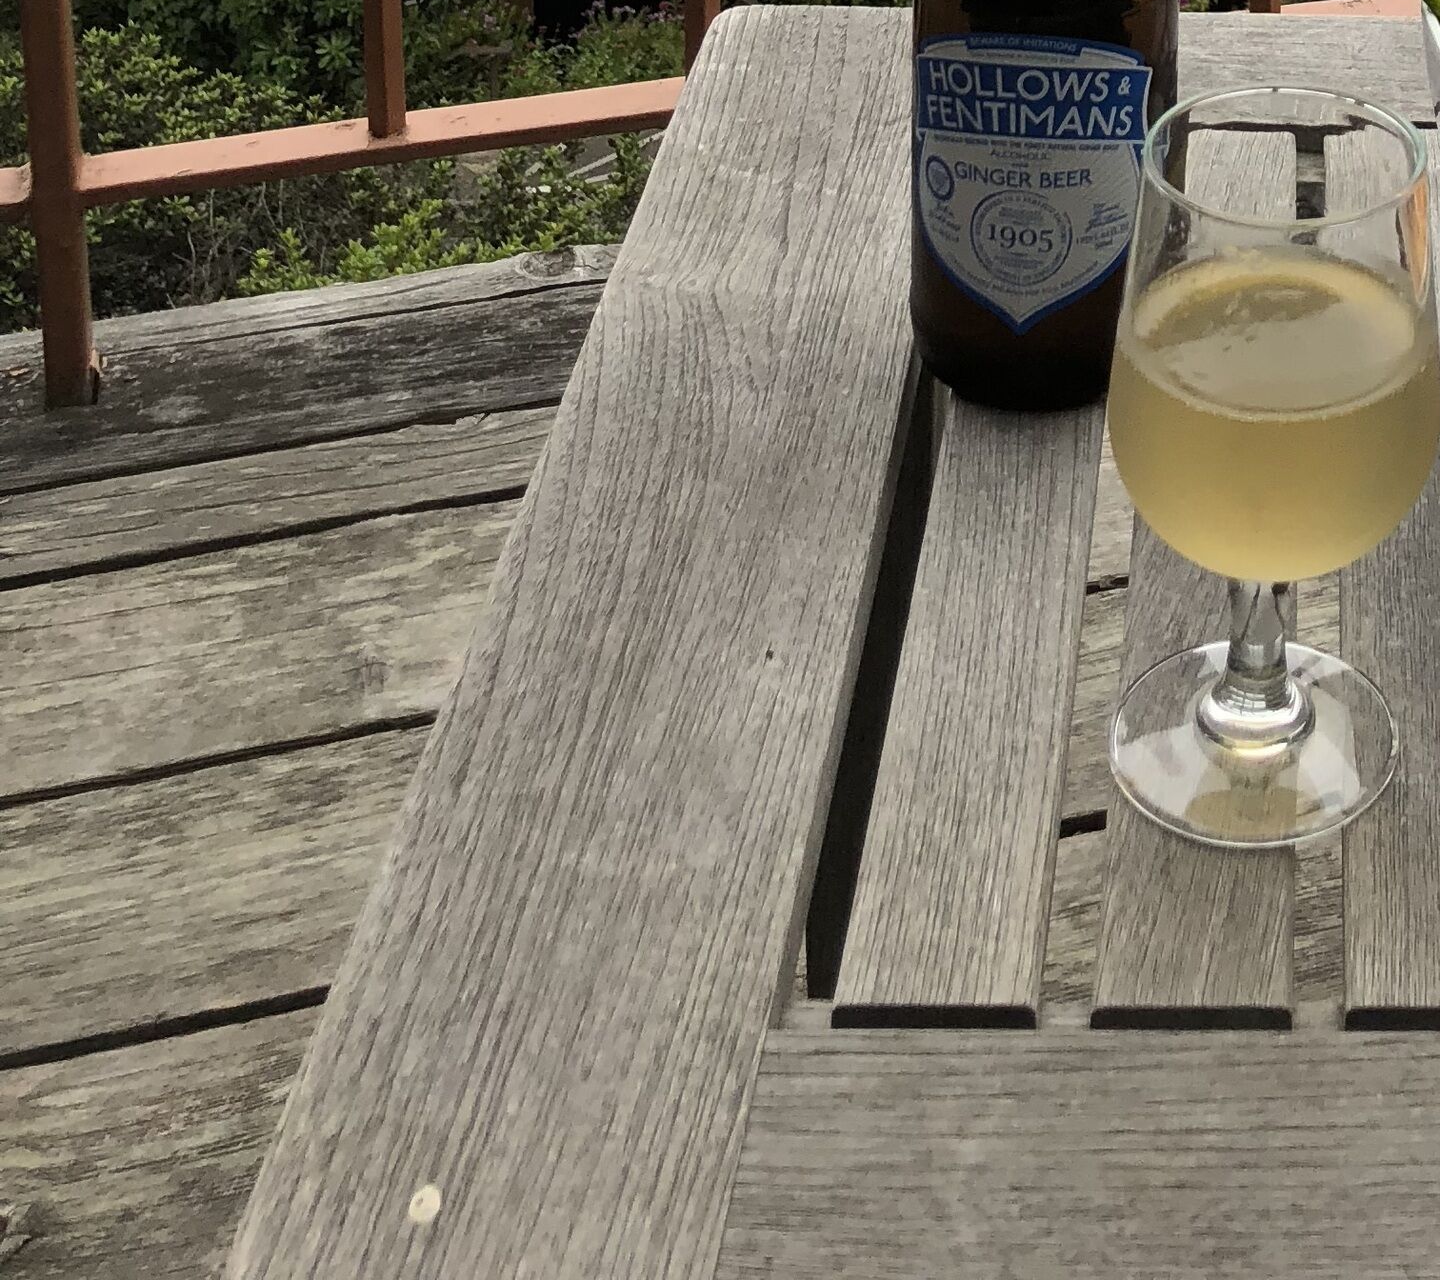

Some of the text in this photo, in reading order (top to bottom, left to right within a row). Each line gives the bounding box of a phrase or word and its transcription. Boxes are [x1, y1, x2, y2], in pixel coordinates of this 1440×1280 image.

[928, 60, 1131, 103] HOLLOWS &
[927, 95, 1134, 137] FENTIMANS
[953, 161, 1093, 189] GINGER BEER
[986, 223, 1054, 255] 1905
